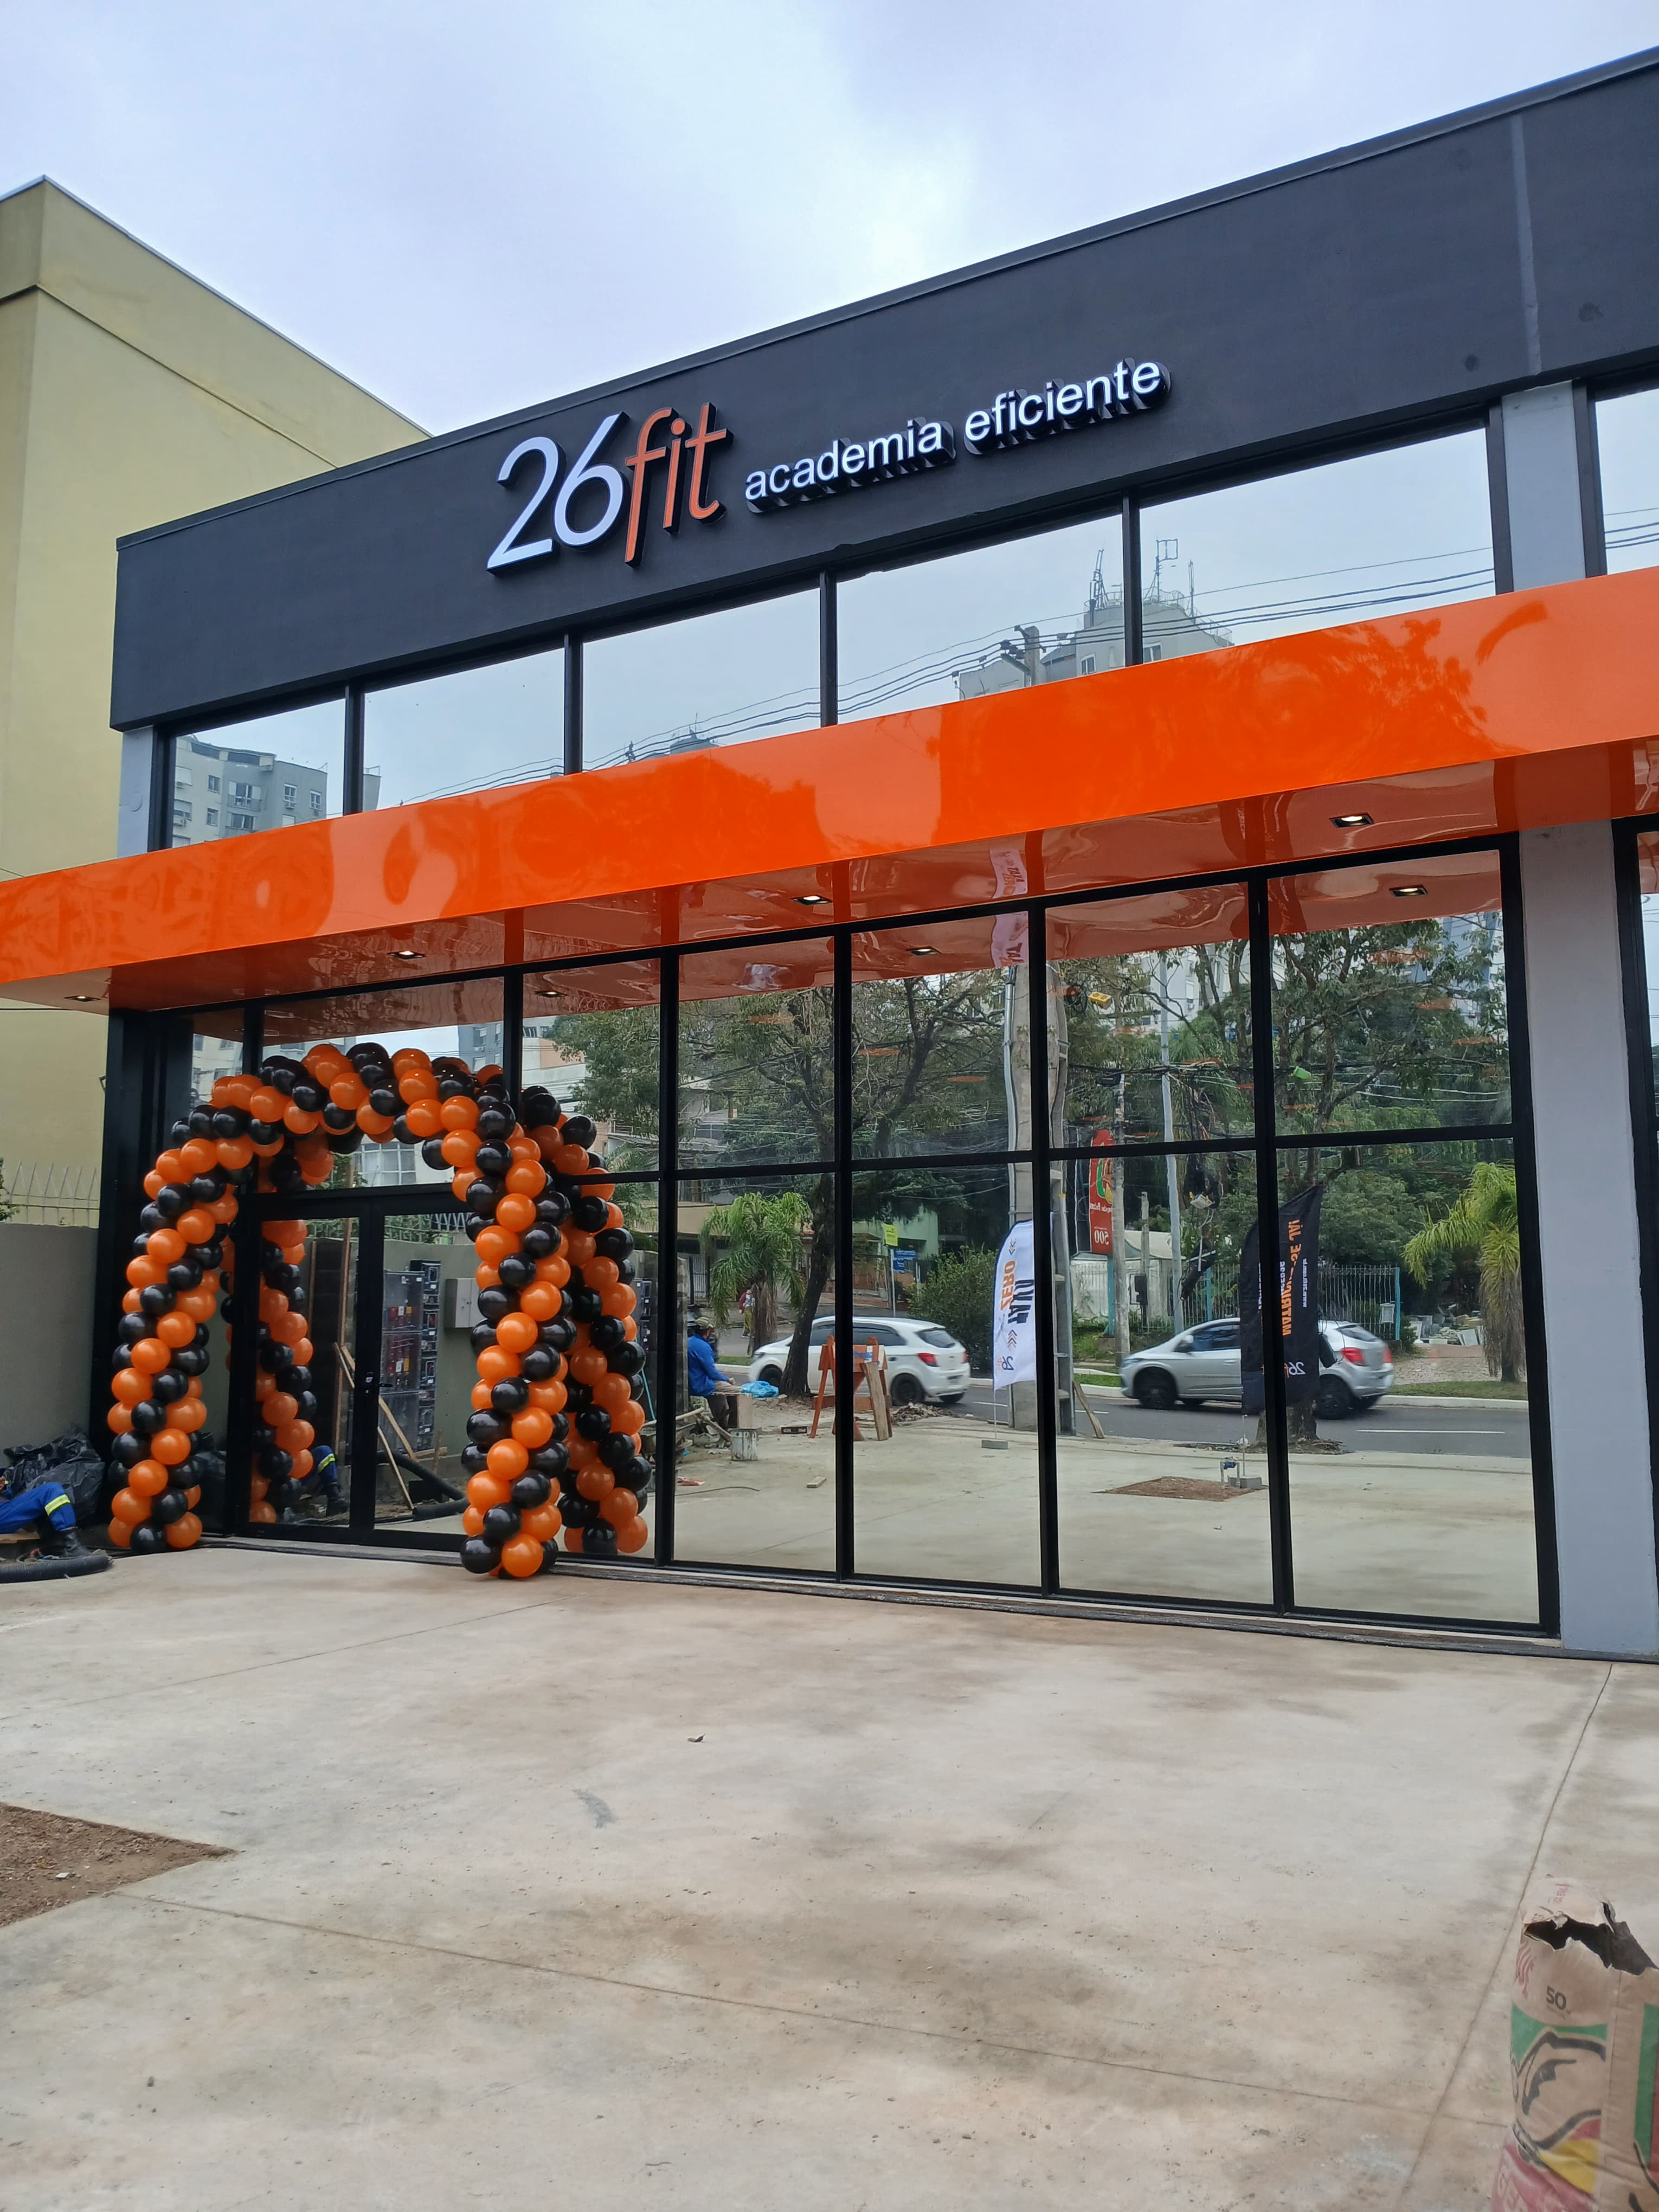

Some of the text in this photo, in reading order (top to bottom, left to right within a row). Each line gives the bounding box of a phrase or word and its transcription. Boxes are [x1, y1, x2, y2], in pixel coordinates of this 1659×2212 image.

[487, 402, 732, 570] 26fit
[744, 359, 1163, 503] academia eficiente
[1546, 1985, 1567, 2011] 50
